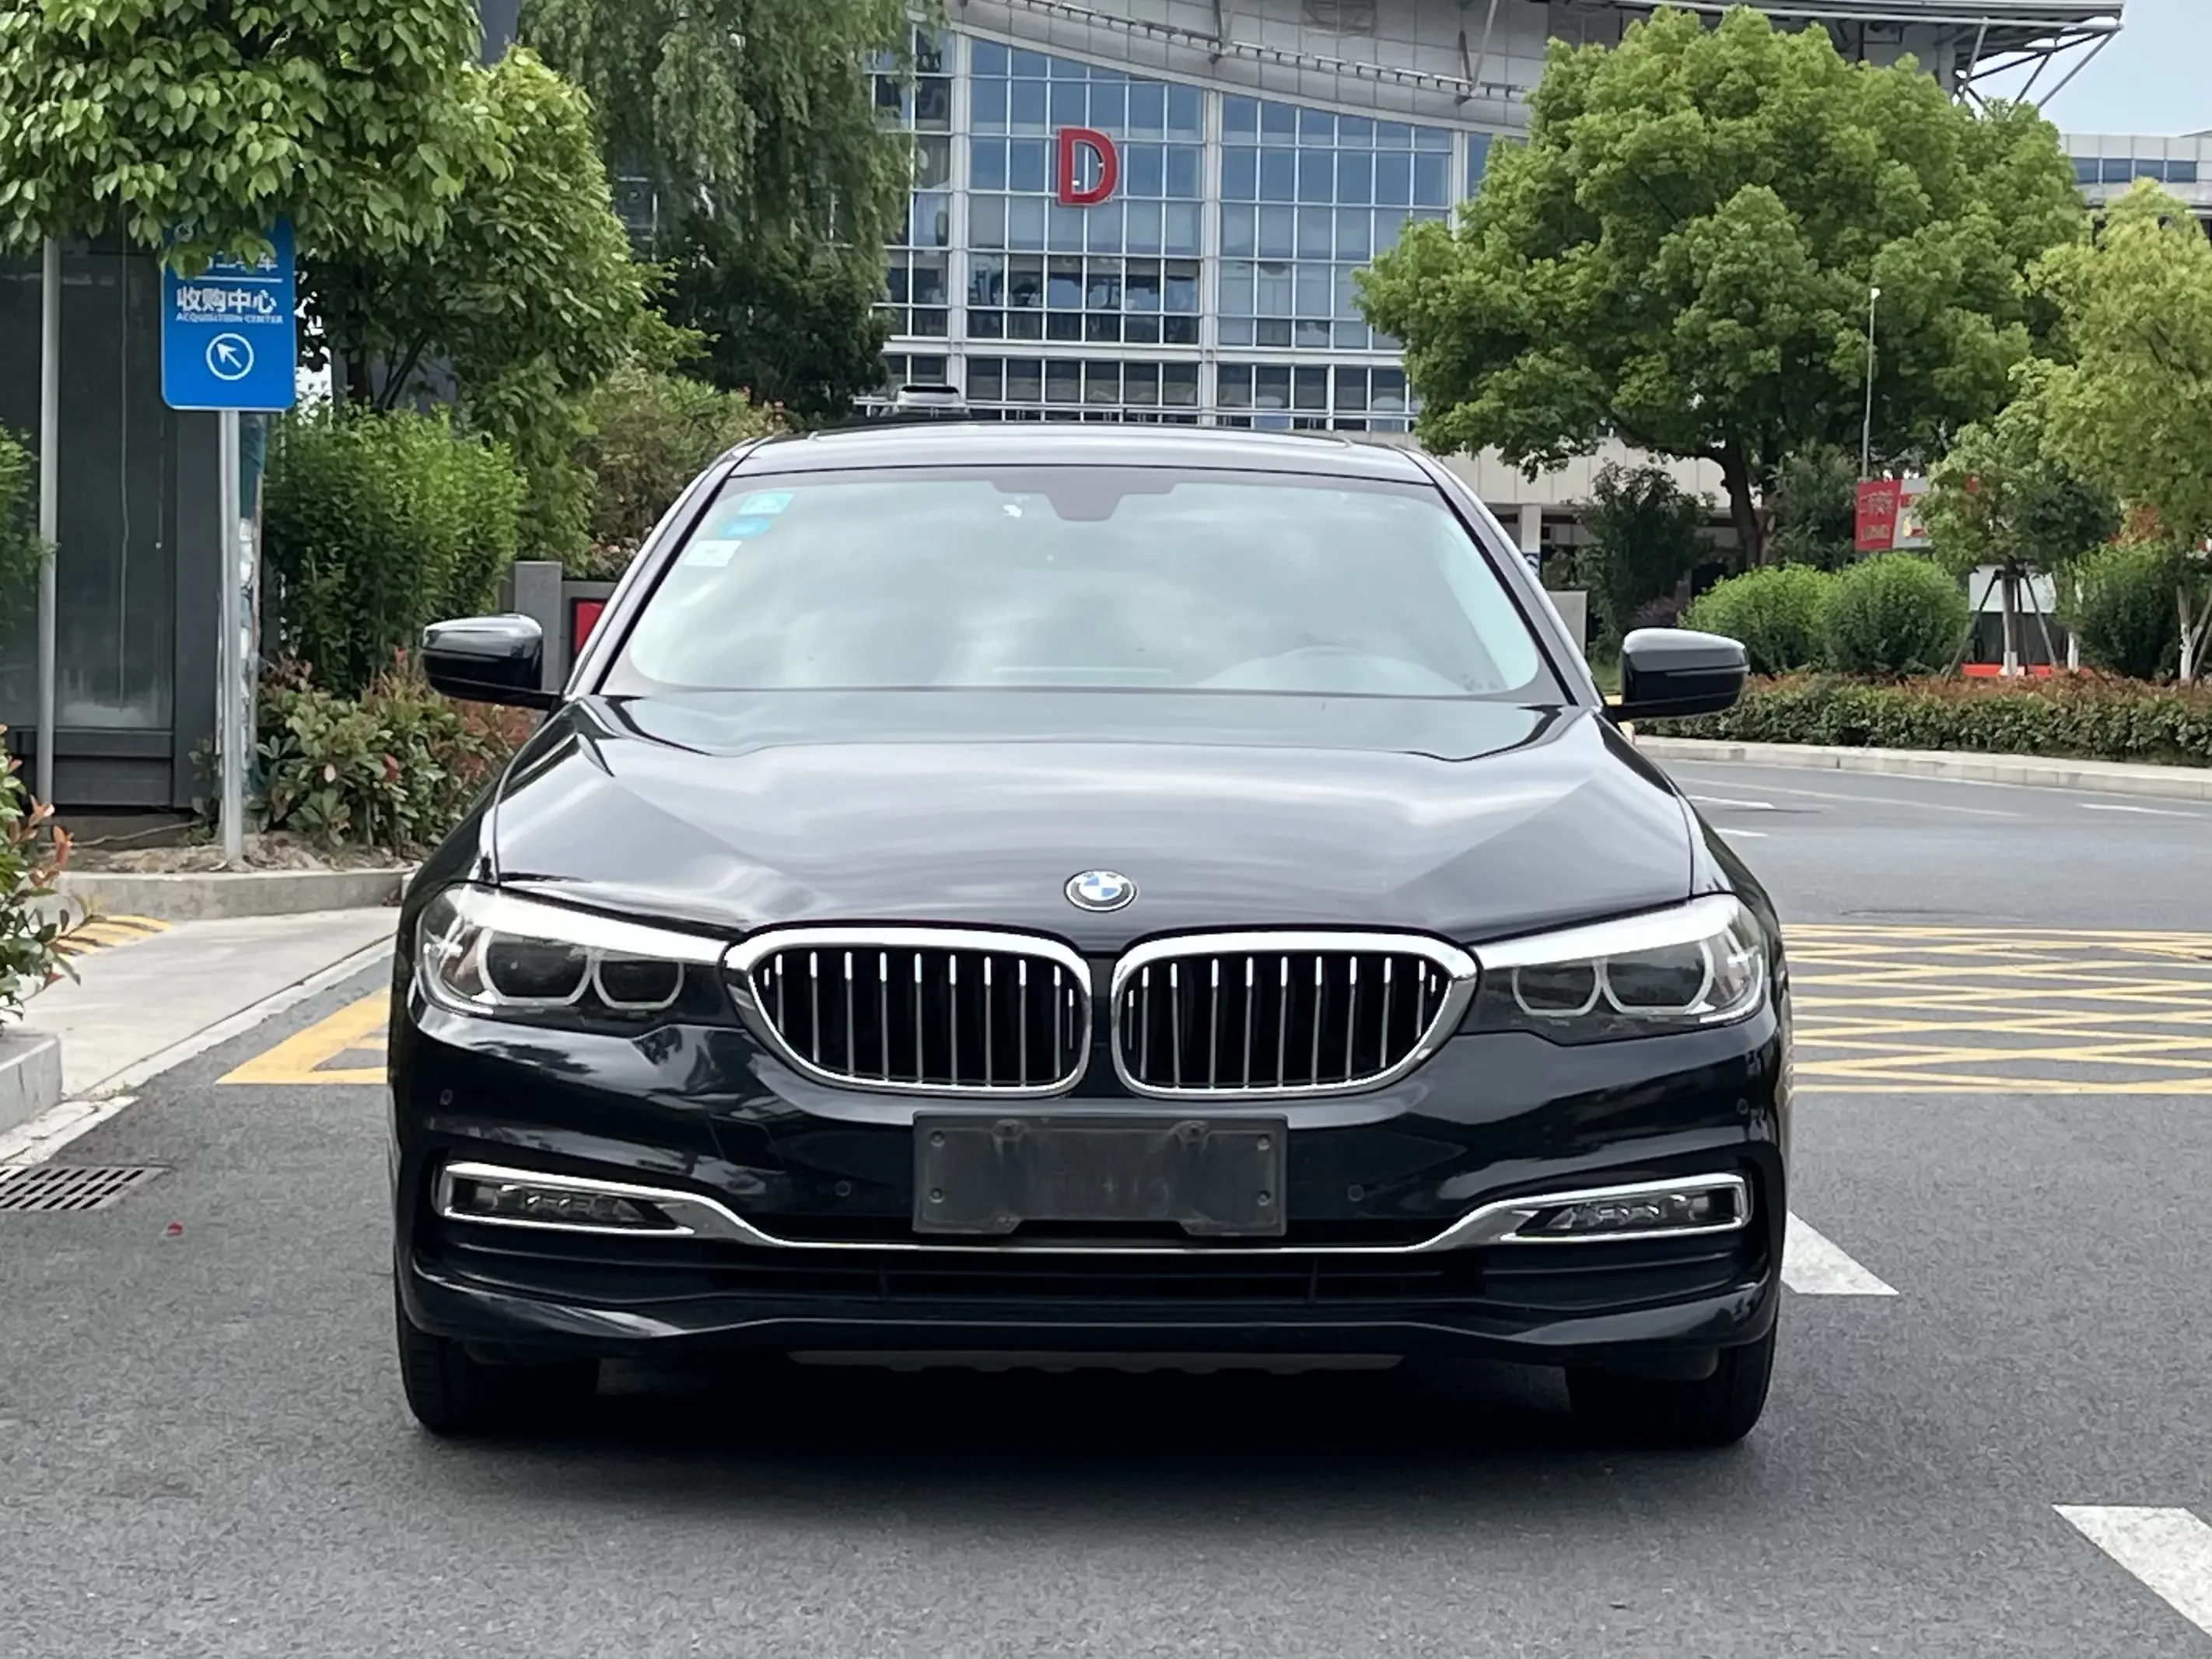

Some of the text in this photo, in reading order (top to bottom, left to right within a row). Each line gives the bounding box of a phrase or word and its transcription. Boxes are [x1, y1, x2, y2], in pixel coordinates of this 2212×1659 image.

[1058, 126, 1119, 205] D
[176, 286, 278, 314] 收购中心
